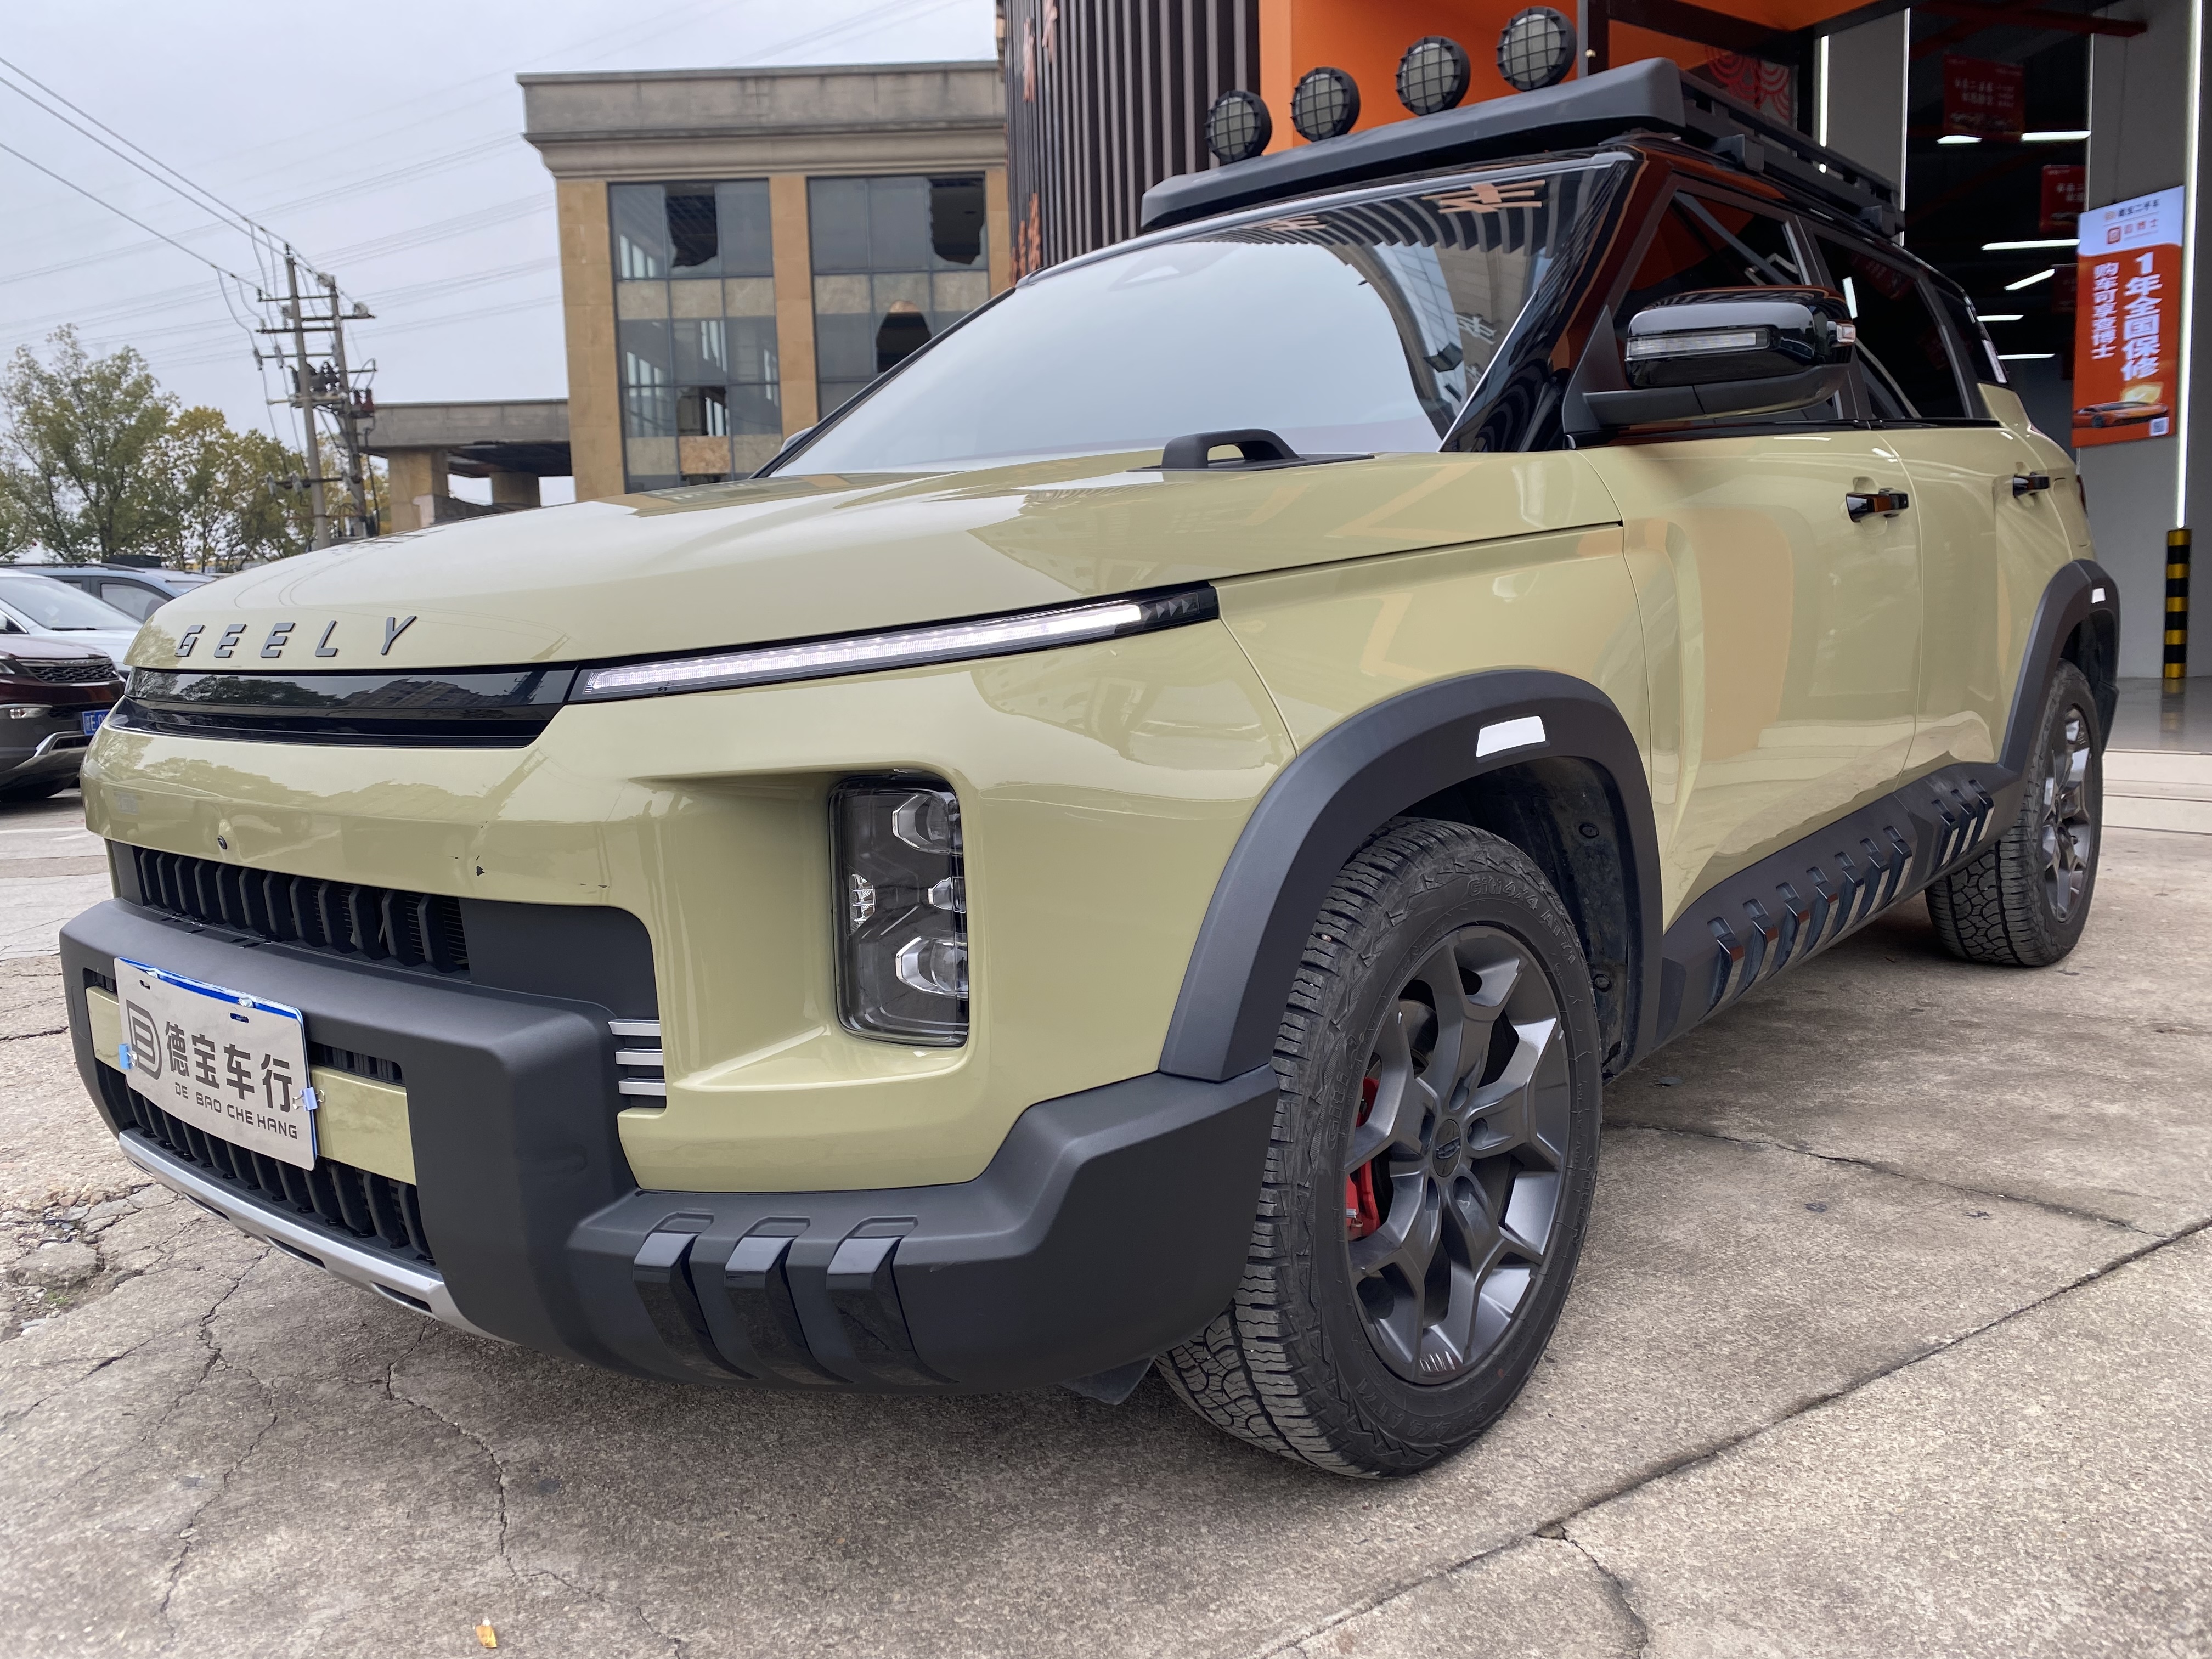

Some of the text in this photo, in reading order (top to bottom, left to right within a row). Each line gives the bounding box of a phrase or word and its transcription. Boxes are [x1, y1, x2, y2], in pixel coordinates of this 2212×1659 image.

[2121, 251, 2163, 382] 1年全国保修
[174, 615, 418, 658] GEELY
[1468, 877, 1502, 897] Giti
[165, 1020, 293, 1113] 德宝车行
[174, 1081, 298, 1140] DE BAO CHE HANG
